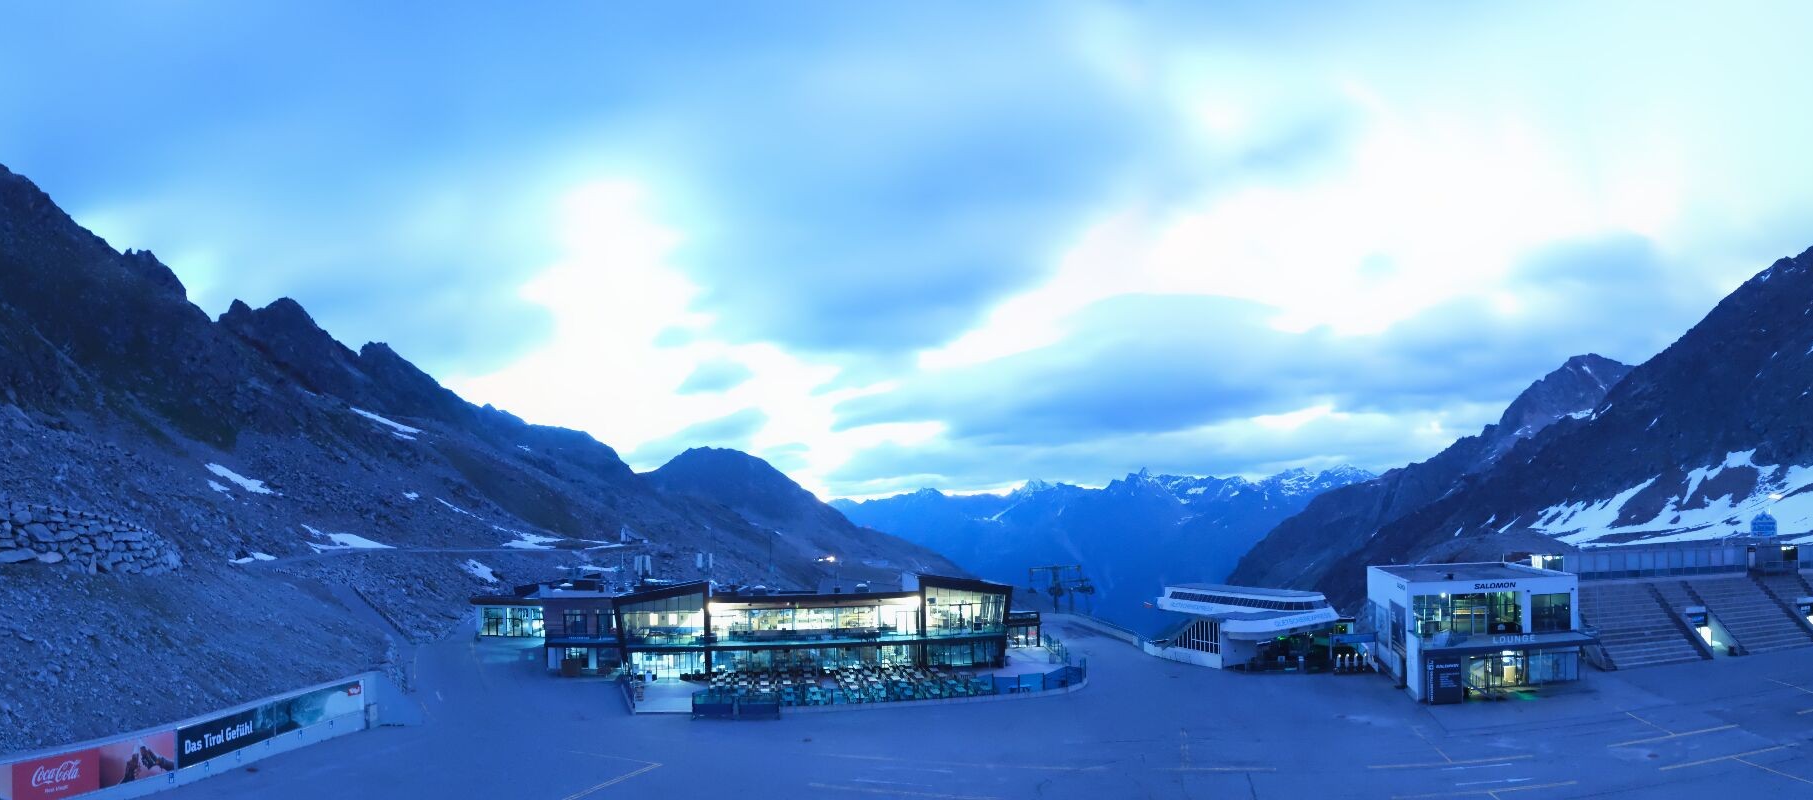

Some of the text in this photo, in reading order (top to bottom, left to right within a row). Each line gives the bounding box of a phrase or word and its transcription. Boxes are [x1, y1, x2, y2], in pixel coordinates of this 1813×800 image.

[1474, 582, 1516, 590] SALOMON
[1493, 635, 1536, 644] LOUNGE
[184, 720, 254, 755] Das Tirol Gefühl
[31, 759, 82, 788] Coca-Cola
